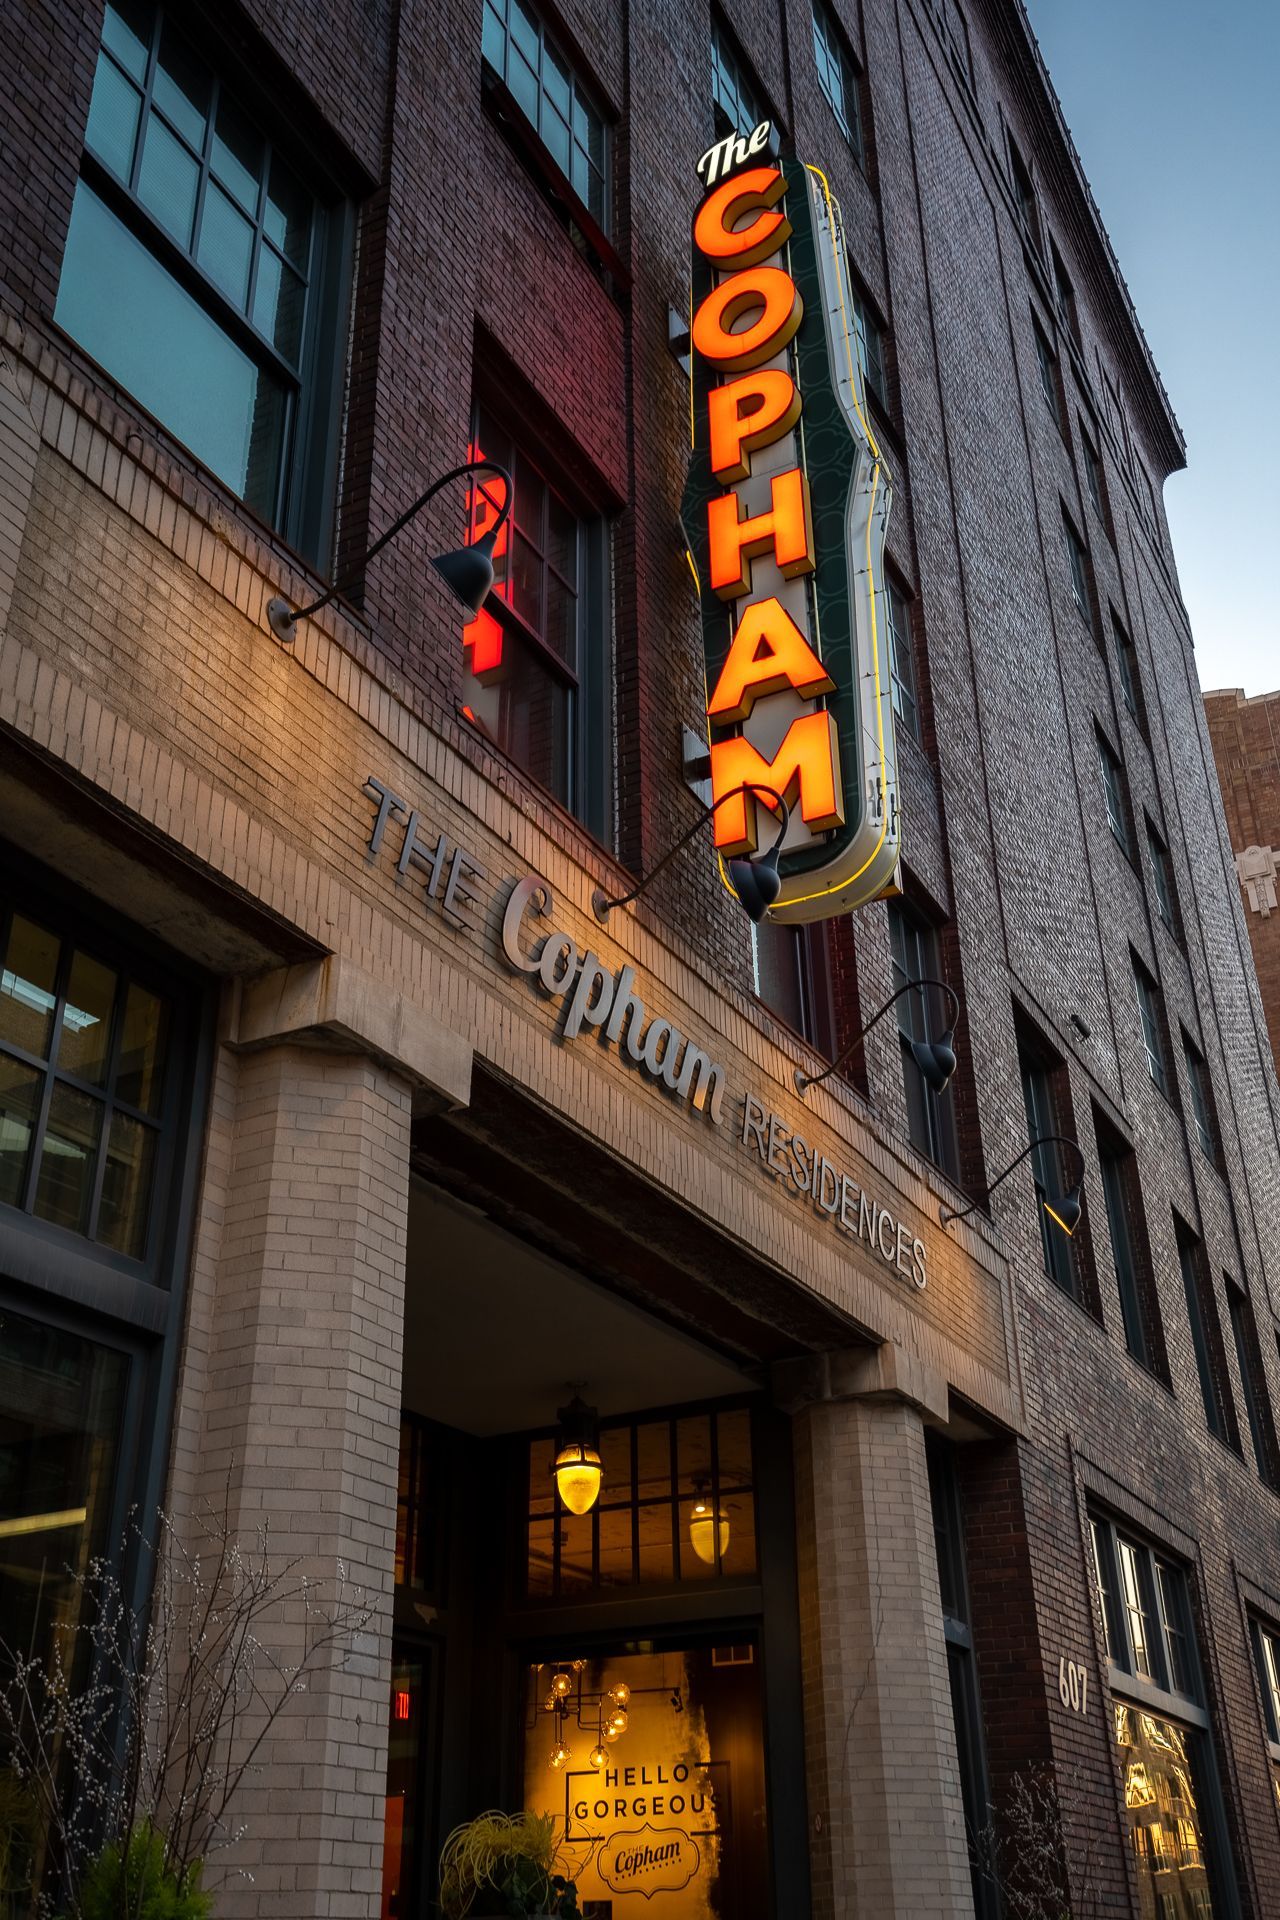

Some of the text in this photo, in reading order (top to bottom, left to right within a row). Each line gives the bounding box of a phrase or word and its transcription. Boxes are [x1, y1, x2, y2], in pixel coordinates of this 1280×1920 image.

[697, 119, 771, 187] The
[693, 166, 845, 856] COPHAM
[363, 775, 928, 1290] THE Copham RESIDENCES
[1059, 1656, 1088, 1715] 607
[605, 1763, 689, 1788] HELLO
[614, 1841, 681, 1876] Copham
